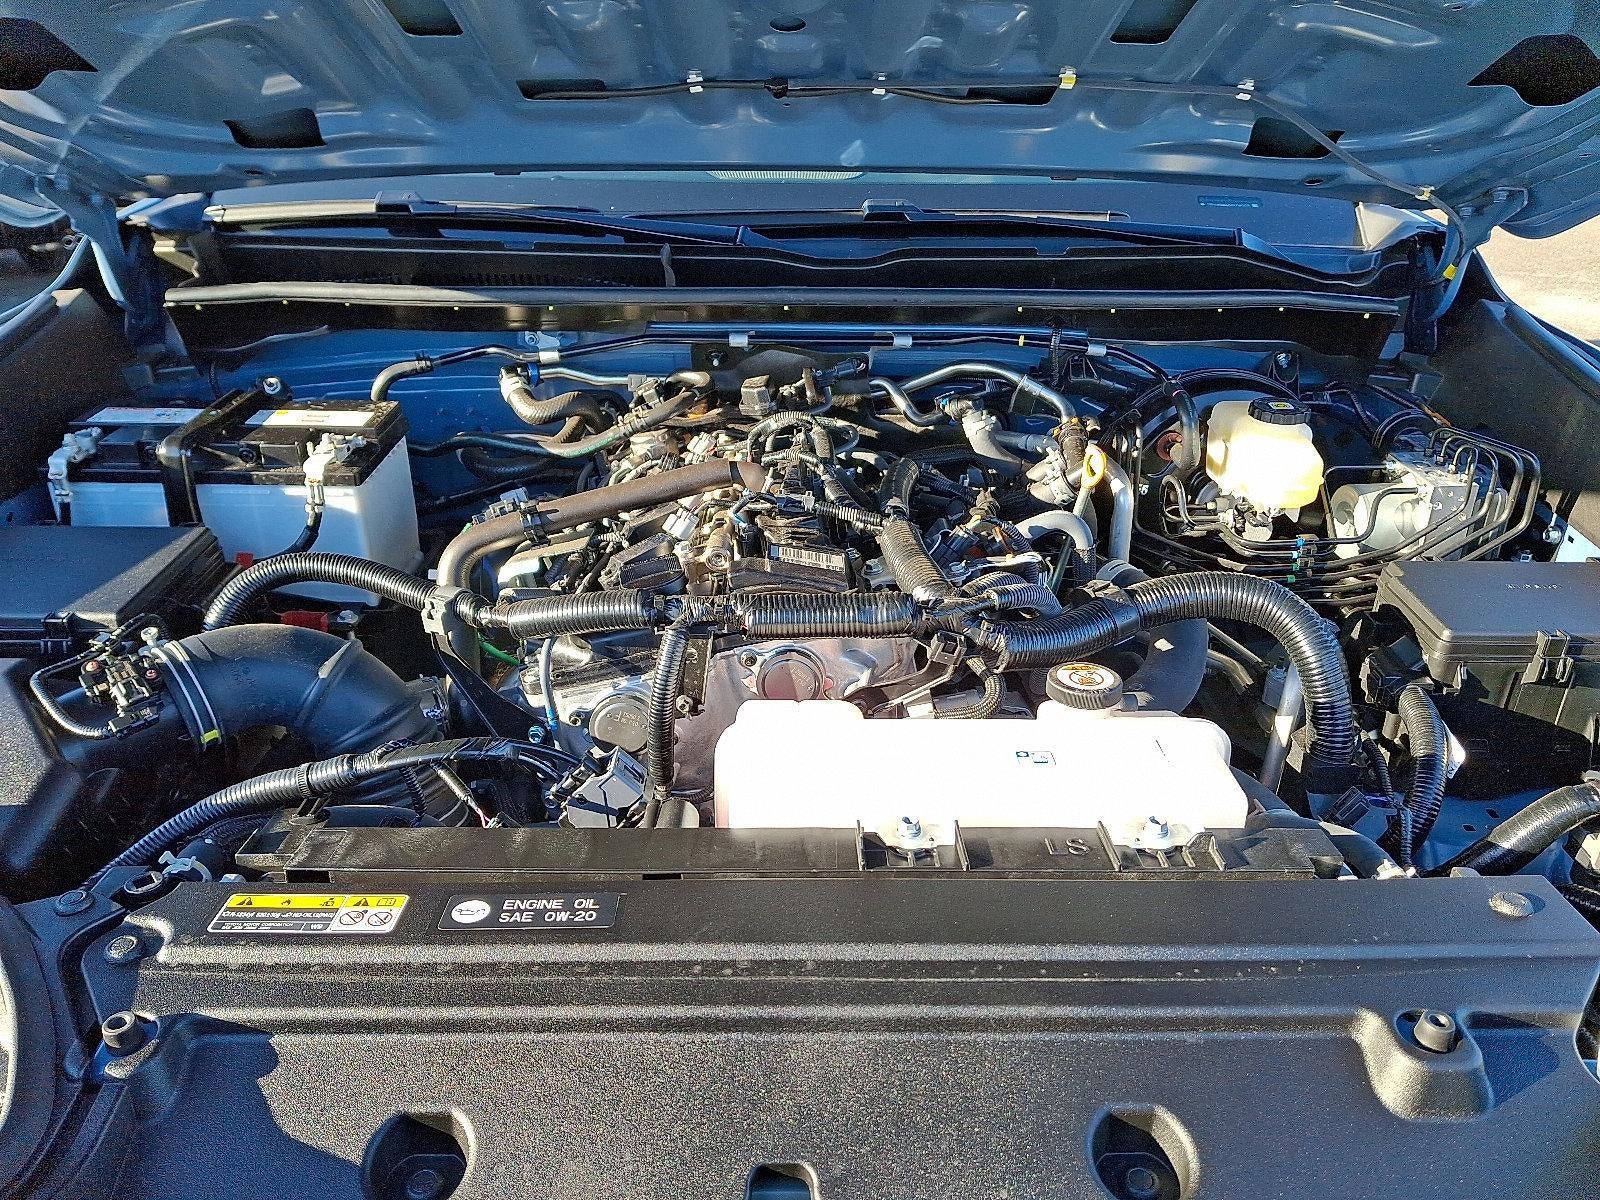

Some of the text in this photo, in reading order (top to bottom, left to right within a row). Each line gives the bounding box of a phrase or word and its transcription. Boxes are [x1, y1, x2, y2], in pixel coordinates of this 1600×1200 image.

[502, 898, 600, 910] ENGINE OIL
[499, 910, 597, 923] SAE 0W-20
